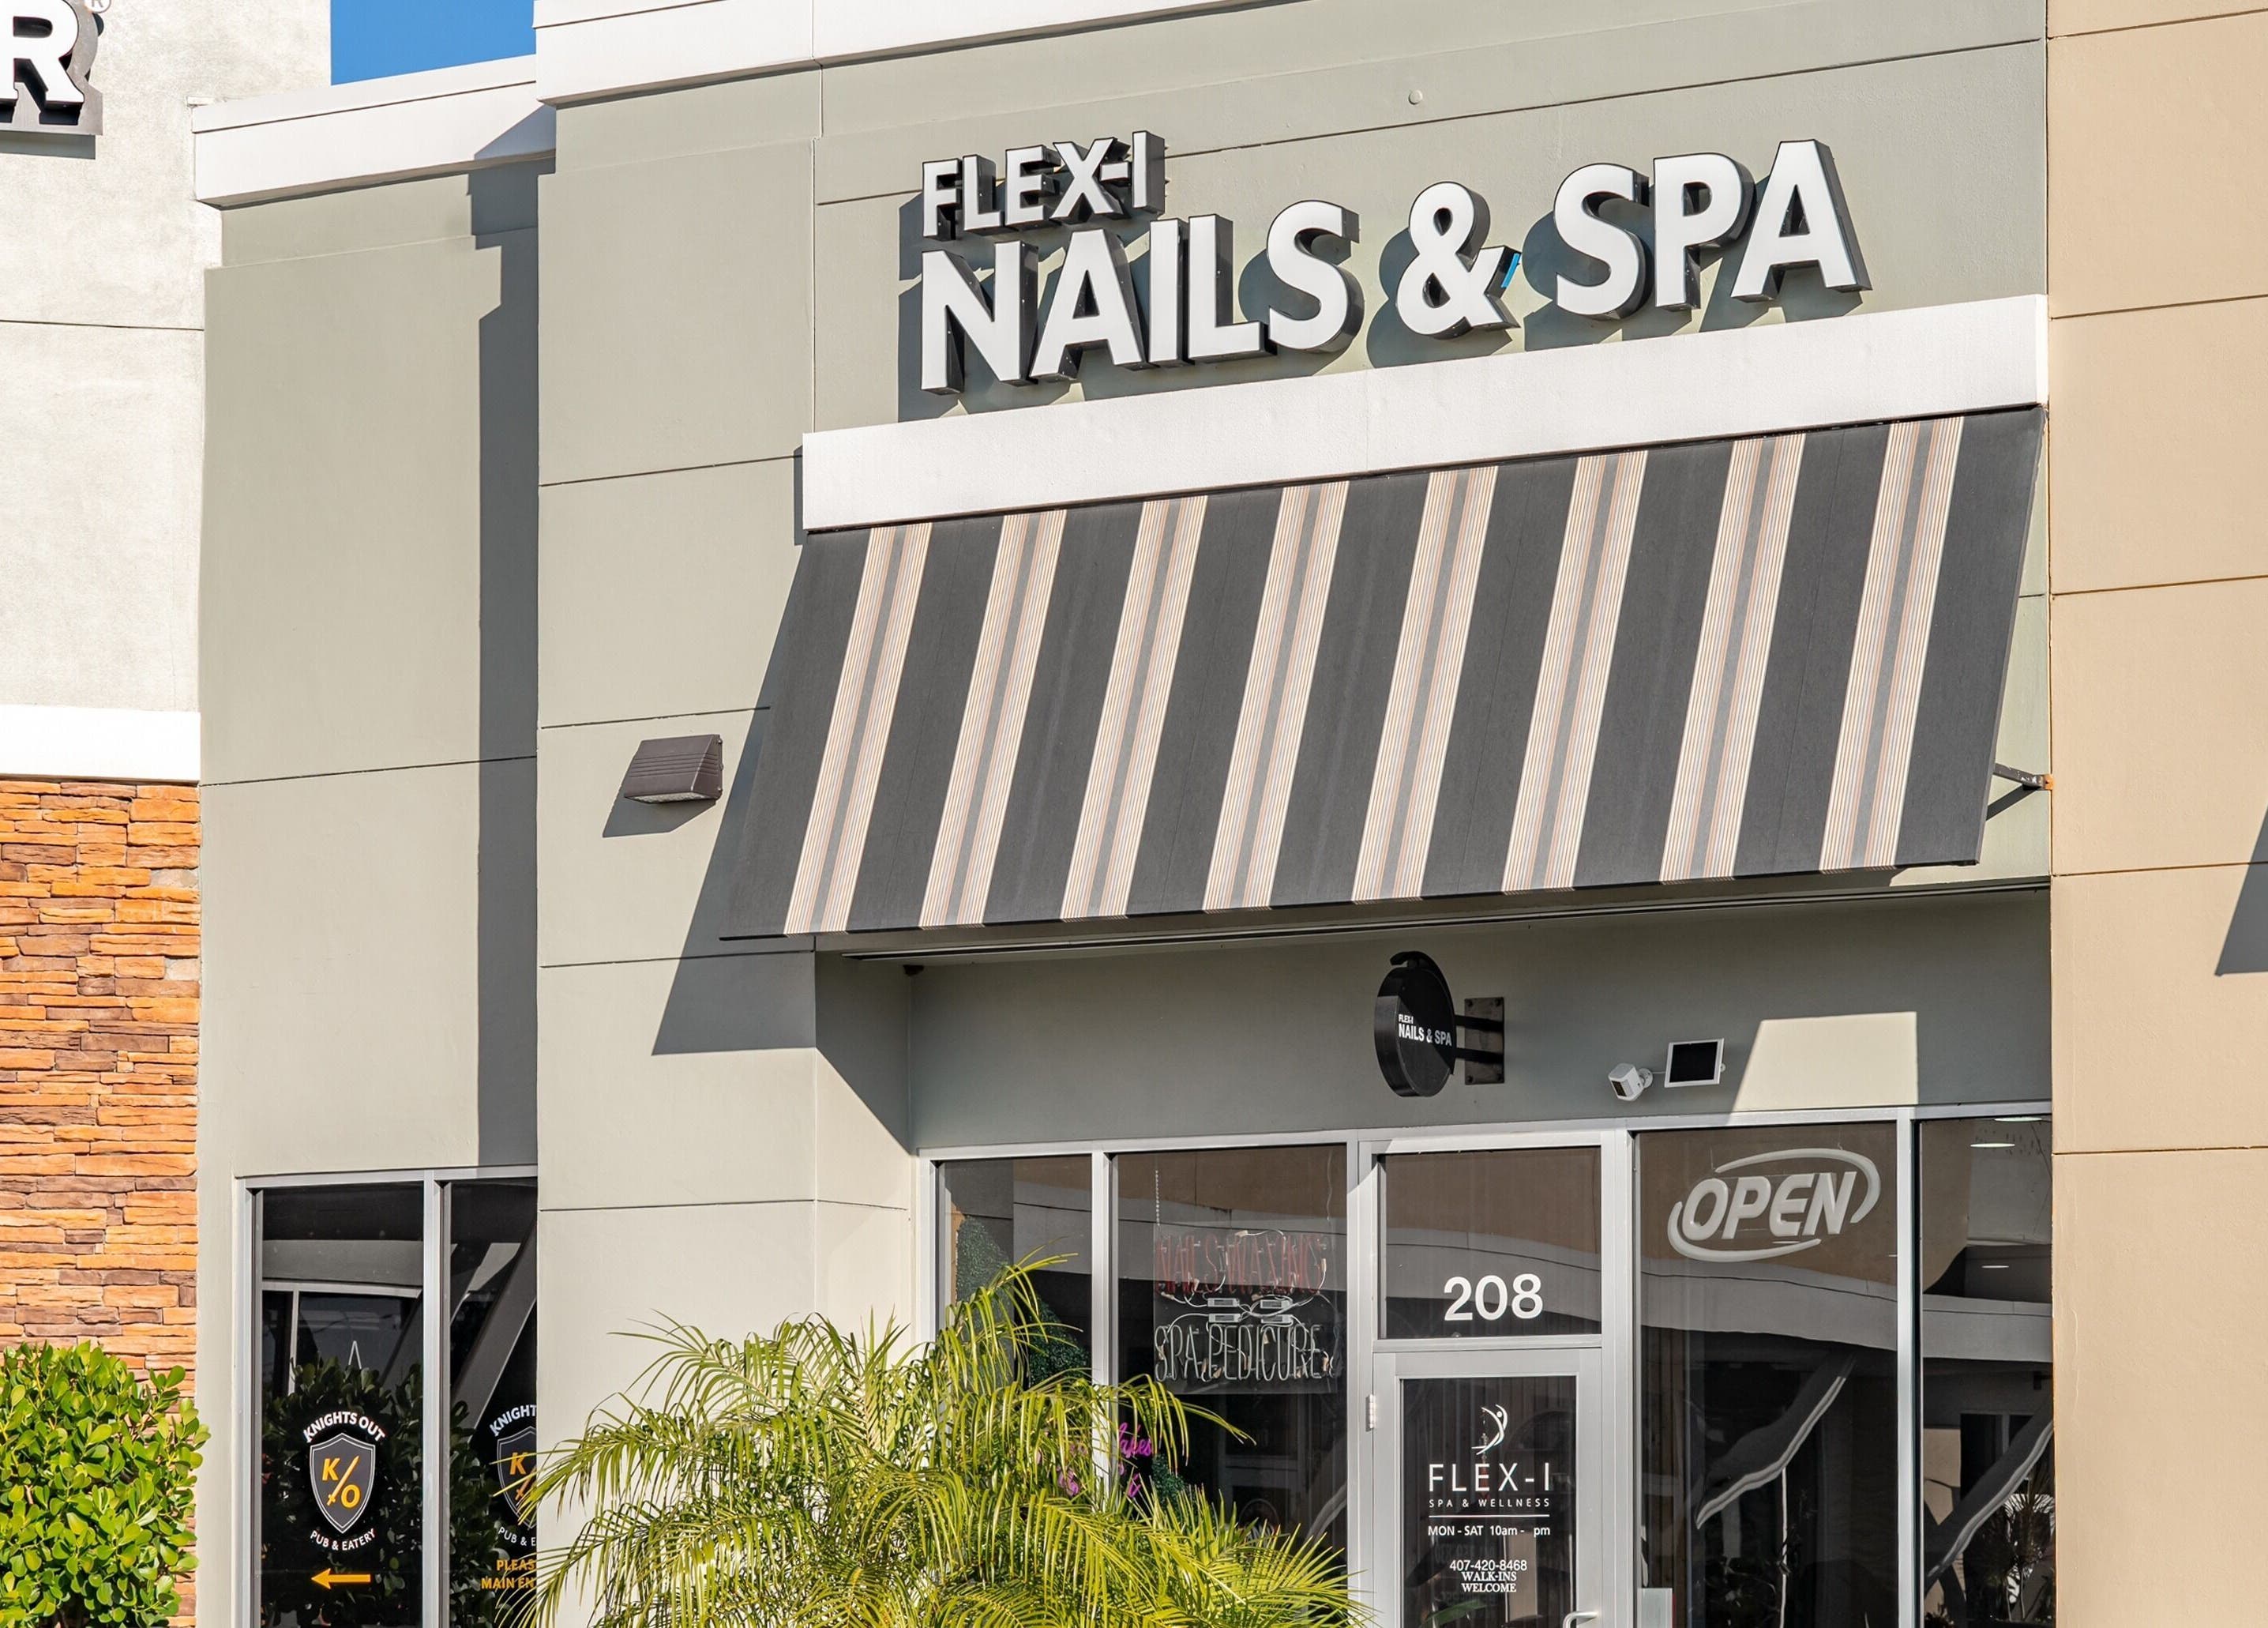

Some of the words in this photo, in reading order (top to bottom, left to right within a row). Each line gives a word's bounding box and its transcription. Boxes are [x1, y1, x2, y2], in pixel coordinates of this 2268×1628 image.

[921, 131, 1165, 239] FLEX-I
[921, 200, 1360, 393] NAILS
[1395, 181, 1520, 340] &
[1556, 140, 1872, 321] SPA
[1399, 1023, 1425, 1042] NAILS
[1426, 1028, 1433, 1043] &
[1435, 1030, 1451, 1047] SPA
[1682, 1171, 1857, 1241] OPEN
[1444, 1273, 1543, 1321] 208
[1155, 1323, 1200, 1382] SPA
[1208, 1322, 1323, 1382] PEDICURE
[303, 1411, 358, 1443] KNIGHTS
[358, 1418, 386, 1442] OUT
[1429, 1462, 1550, 1491] FLEX-I
[1429, 1499, 1453, 1508] SPA
[1462, 1499, 1469, 1508] &
[1478, 1498, 1549, 1508] WELLNESS
[310, 1529, 329, 1548] PUB
[332, 1540, 339, 1551] &
[342, 1528, 376, 1551] EATERY
[498, 1526, 517, 1543] PUB
[520, 1538, 527, 1547] &
[1428, 1525, 1455, 1536] MON
[1464, 1525, 1484, 1536] SAT
[1489, 1525, 1518, 1536] 10am
[1534, 1527, 1550, 1538] pm
[1449, 1559, 1527, 1571] 407-420-8468
[1461, 1571, 1517, 1581] WALK-INS
[482, 1577, 514, 1590] MAIN
[1461, 1582, 1517, 1592] WELCOME
